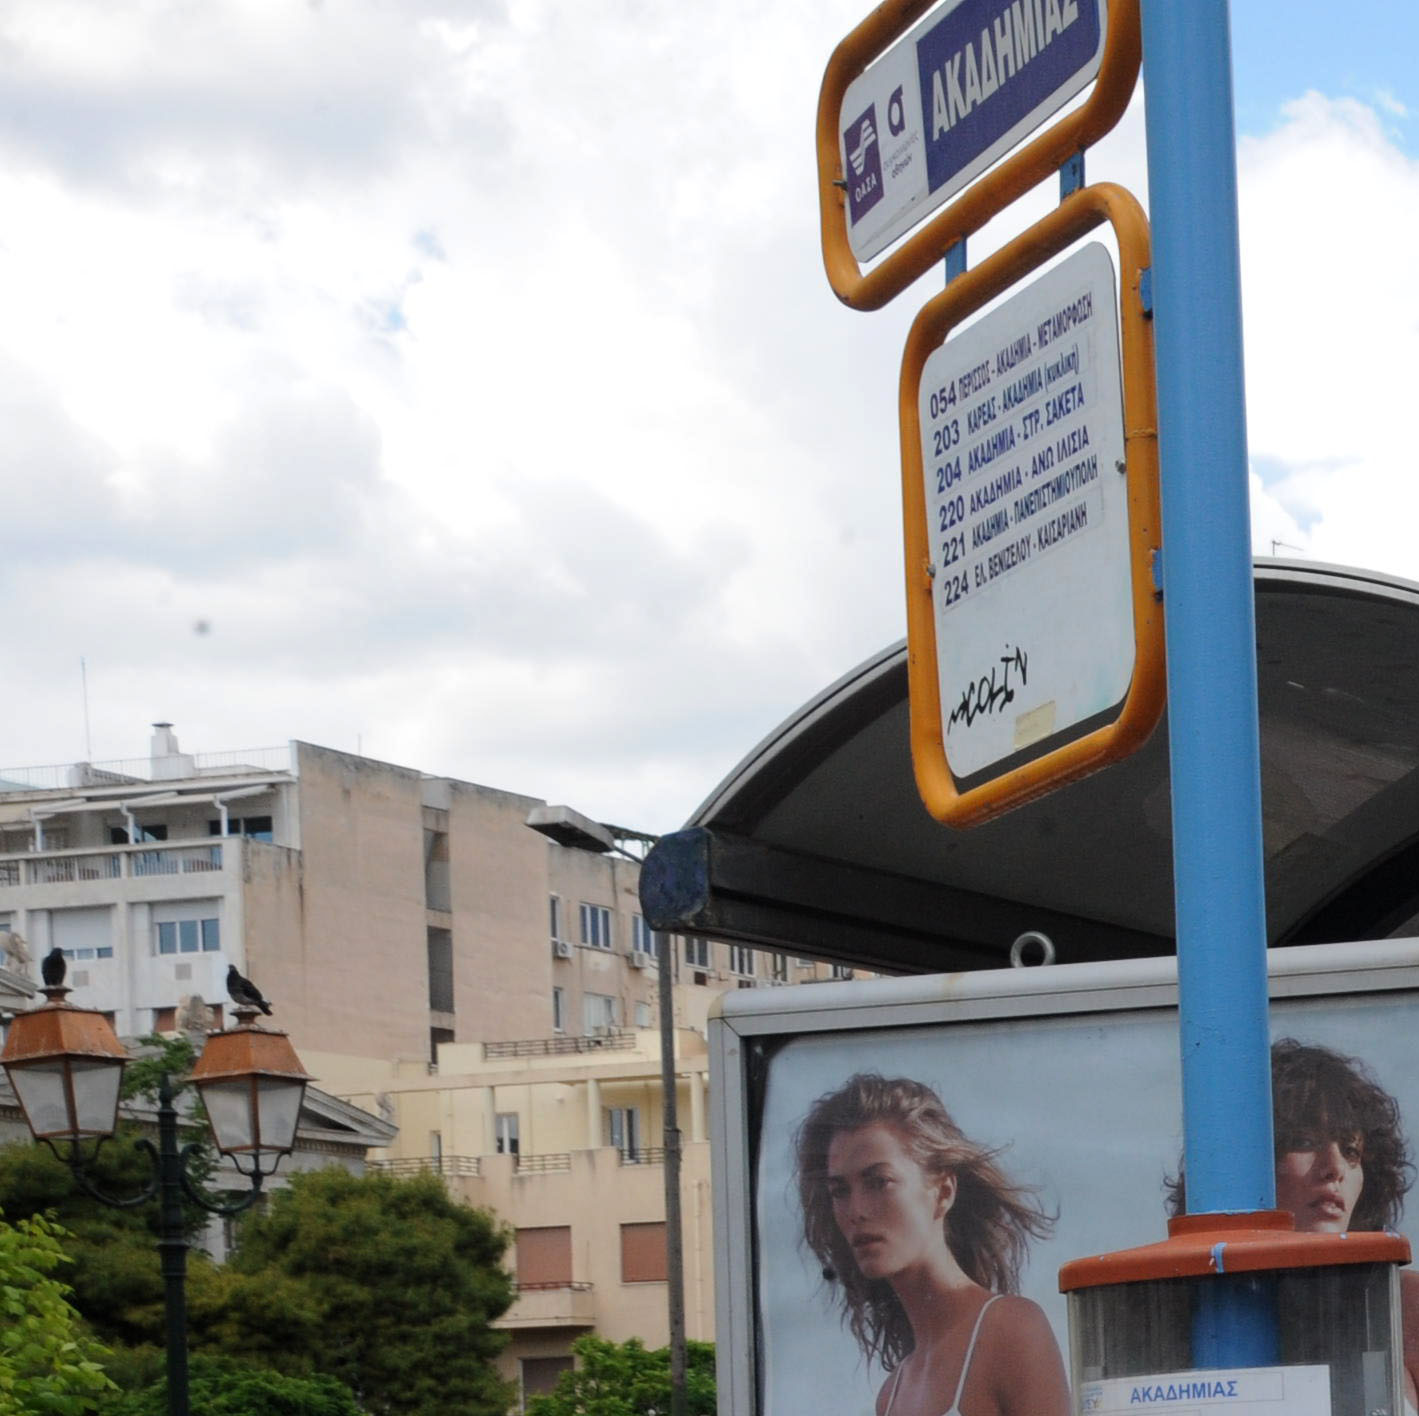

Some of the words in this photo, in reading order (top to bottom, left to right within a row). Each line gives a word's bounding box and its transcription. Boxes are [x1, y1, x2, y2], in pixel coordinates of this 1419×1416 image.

[930, 381, 957, 420] 054
[996, 333, 1032, 377] ΑΚΑΔΗΜΙΑ
[1037, 291, 1093, 350] ΜΕΤΑΜΟΡΦΩΣΗ
[933, 419, 960, 458] 203
[967, 396, 997, 436] ΚΑΡΕΑΣ
[1002, 367, 1043, 413] ΑΚΑΔΗΜΙΑ
[936, 456, 962, 495] 204
[968, 425, 1016, 475] ΑΚΑΔΗΜΙΑ
[1022, 408, 1044, 441] ΣΤΡ.
[1045, 382, 1085, 427] ΣΑΚΕΤΑ
[939, 495, 965, 532] 220
[970, 466, 1023, 516] ΑΚΑΔΗΜΙΑ
[1031, 446, 1054, 478] ΑΝΩ
[1056, 425, 1090, 464] ΙΛΙΣΙΑ
[942, 531, 966, 568] 221
[972, 508, 1010, 550] ΑΚΑΔΗΜΙΑ
[1014, 454, 1099, 525] ΠΑΝΕΠΙΣΤΗΜΙΟΥΠΟΛΗ
[944, 570, 969, 607] 224
[988, 533, 1032, 580] ΒΕΝΙΖΕΛΟΥ
[1037, 501, 1088, 552] ΚΑΙΣΑΡΙΑΝΗ
[1130, 1380, 1239, 1404] ΑΚΑΔΗΜΙΑΣ
